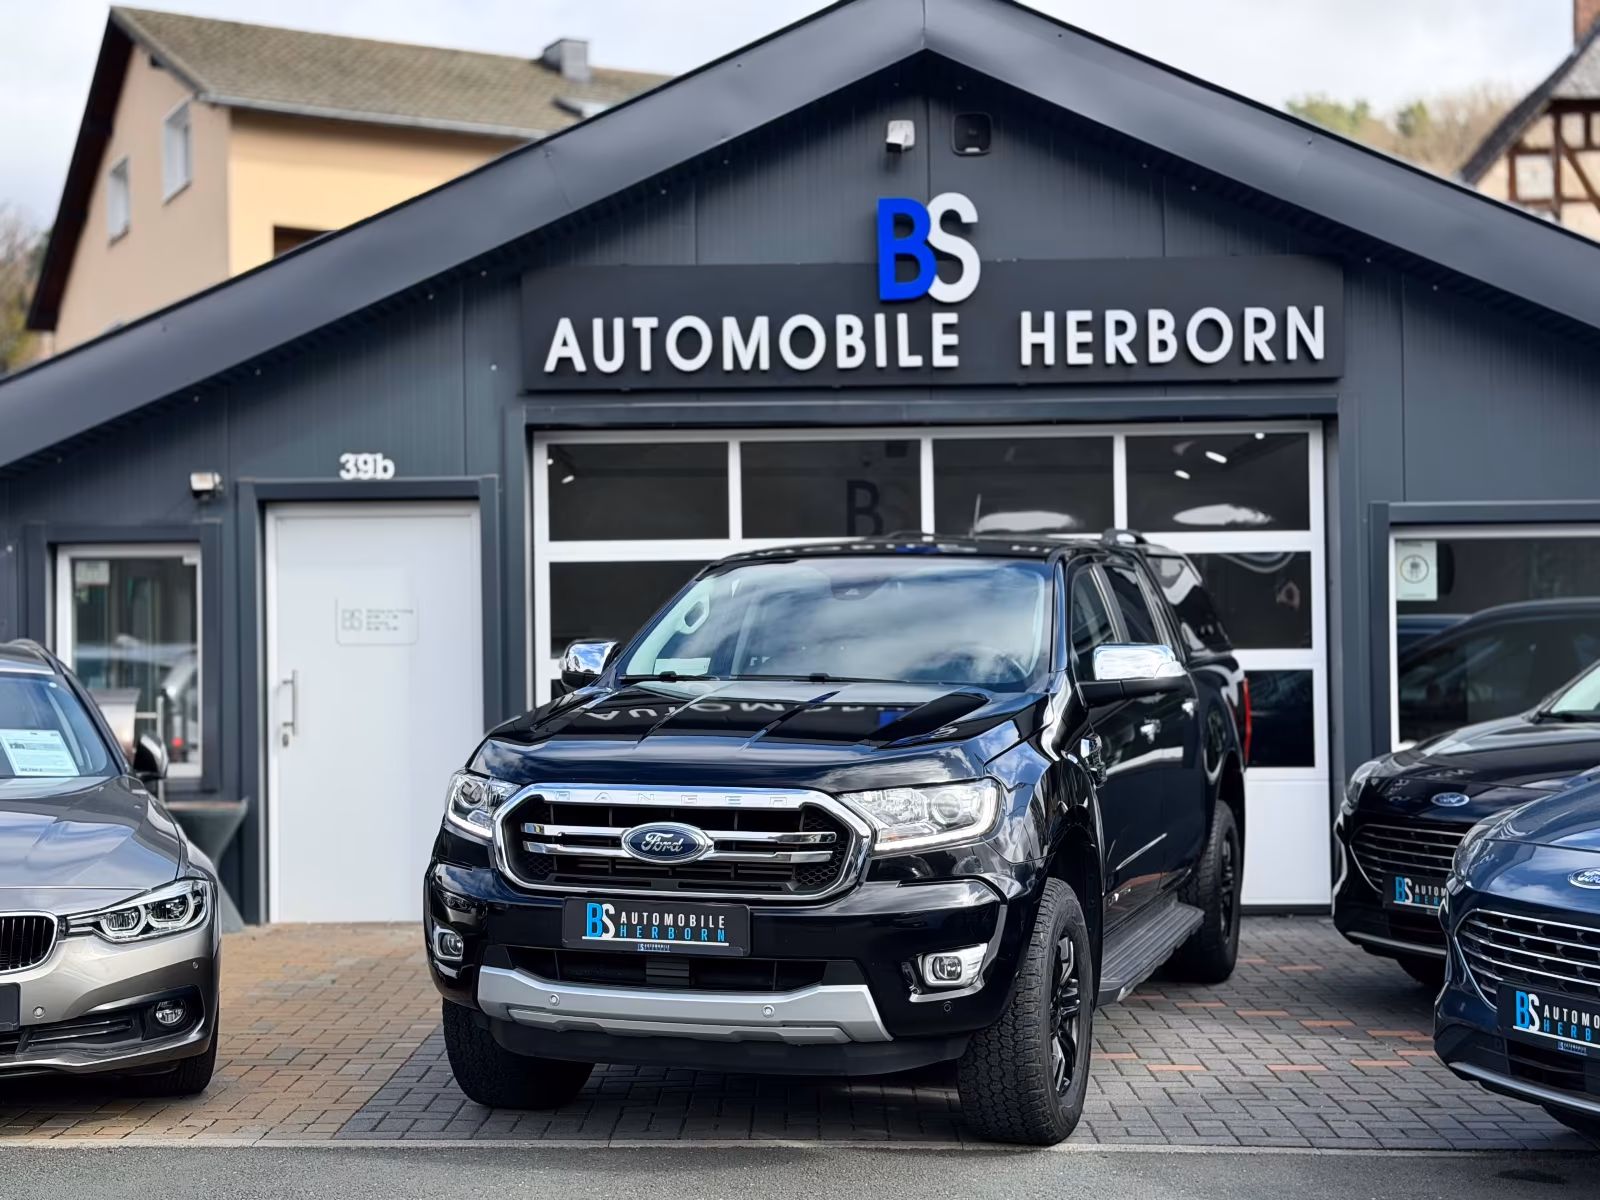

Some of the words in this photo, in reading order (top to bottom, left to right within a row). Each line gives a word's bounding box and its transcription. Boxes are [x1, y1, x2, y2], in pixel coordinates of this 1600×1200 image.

[877, 192, 981, 303] BS
[544, 312, 960, 374] AUTOMOBILE
[1020, 305, 1325, 366] HERBORN
[339, 452, 396, 480] 39b
[555, 791, 788, 806] RANGER
[641, 832, 684, 852] Ford
[1395, 877, 1413, 903] BS
[586, 903, 616, 939] BS
[620, 911, 725, 928] AUTOMOBILE
[620, 925, 725, 941] HERBORN
[1516, 990, 1540, 1031] BS
[1543, 1004, 1600, 1029] AUTOMO
[1543, 1018, 1592, 1041] HERB
